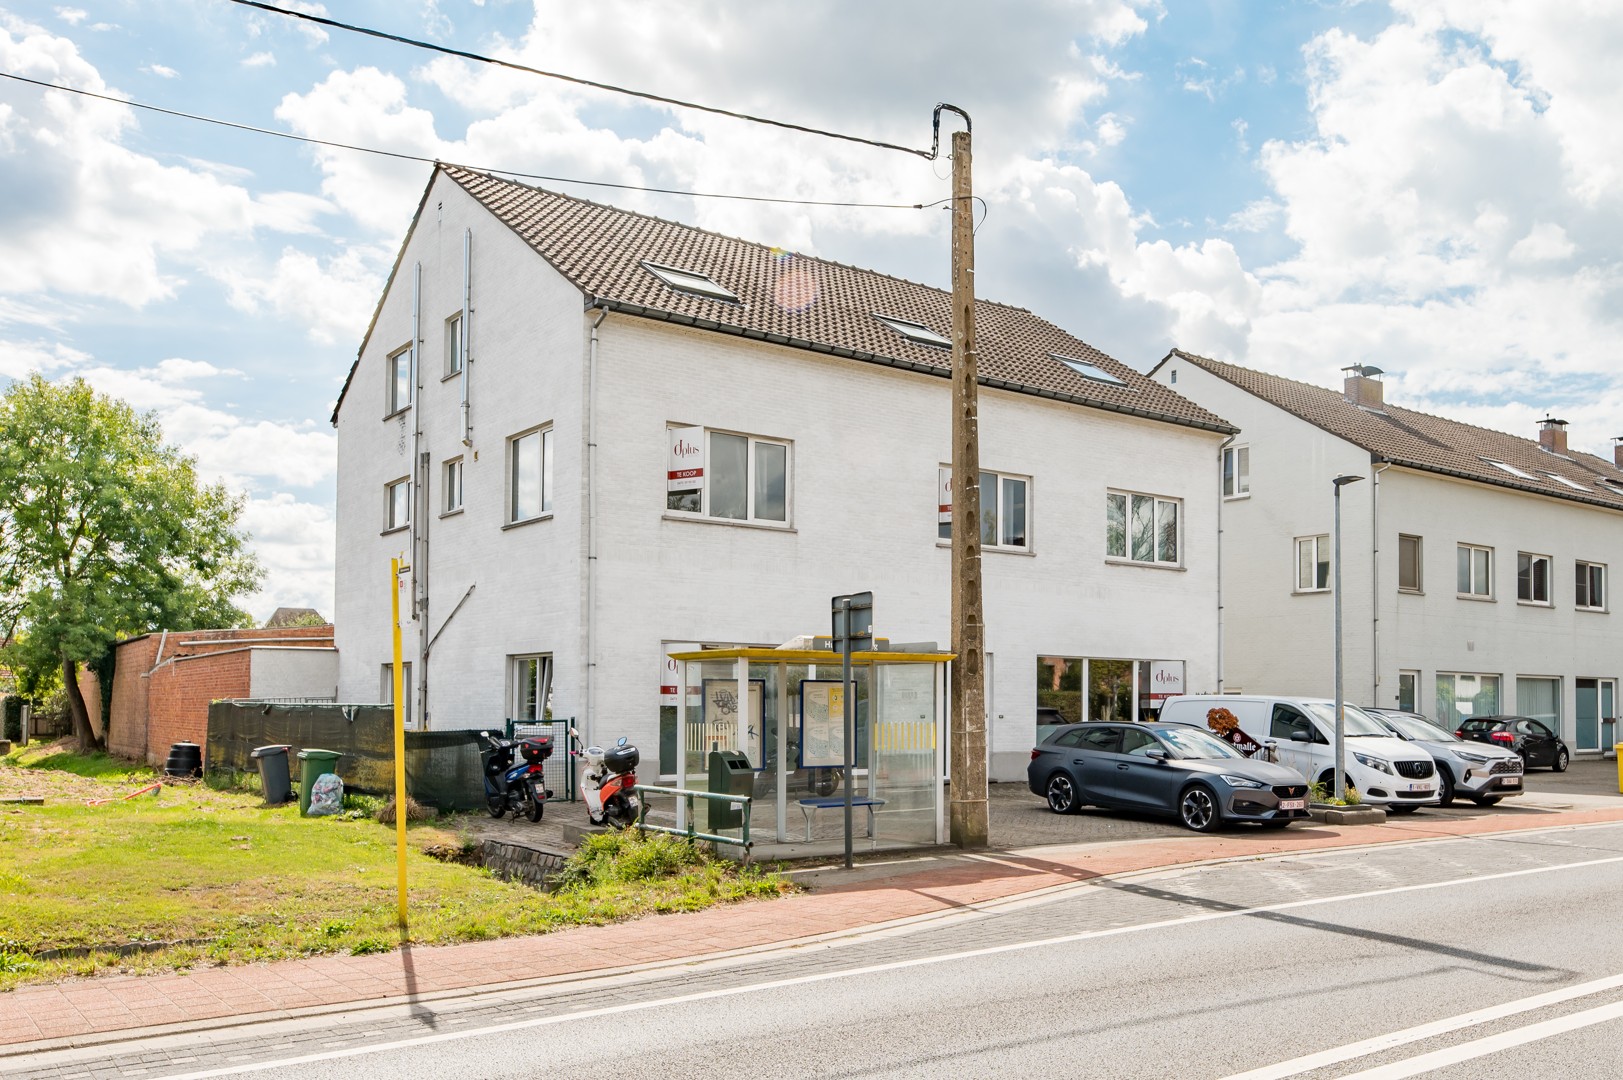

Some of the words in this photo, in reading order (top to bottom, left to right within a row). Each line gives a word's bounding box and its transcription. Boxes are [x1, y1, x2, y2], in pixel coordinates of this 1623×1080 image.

[674, 439, 700, 458] dplus
[1155, 669, 1179, 684] dplus
[670, 686, 676, 694] TE
